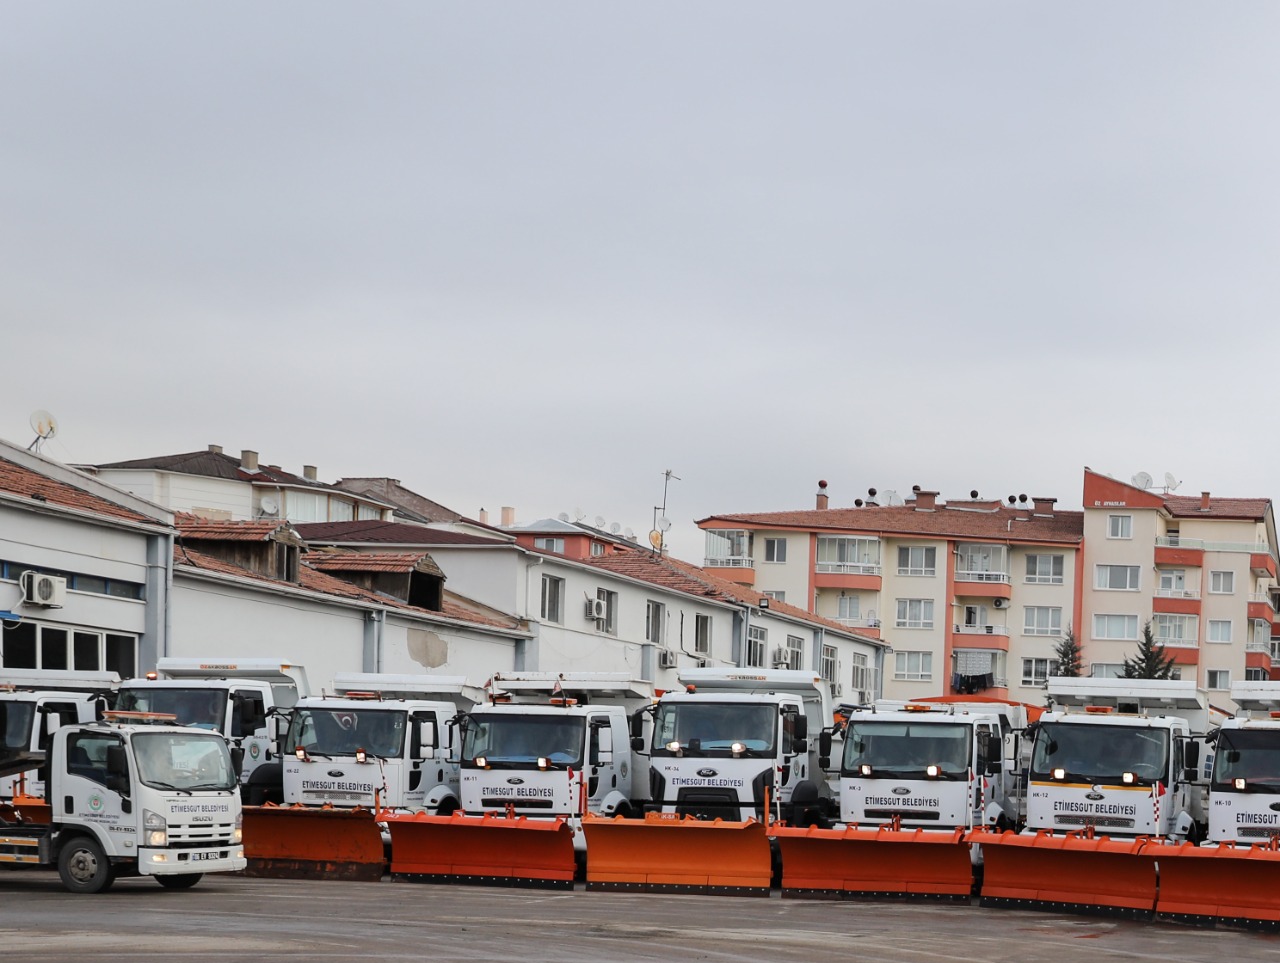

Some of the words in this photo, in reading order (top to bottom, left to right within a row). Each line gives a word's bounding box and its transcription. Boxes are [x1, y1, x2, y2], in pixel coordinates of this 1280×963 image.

[302, 780, 336, 789] ETİMESGUT
[337, 781, 373, 791] BELEDİYESİ
[672, 777, 706, 785] ETİMESGUT
[707, 778, 744, 787] BELEDİYESİ
[482, 787, 513, 796] ETİMESGUT
[516, 787, 554, 797] BELEDİYESİ
[865, 795, 900, 806] ETİMESGUT
[902, 797, 939, 807] BELEDİYESİ
[171, 804, 200, 812] ETİMESGUT
[202, 804, 229, 812] BELEDİYESİ
[1054, 800, 1093, 812] ETİMESGUT
[1095, 803, 1136, 815] BELEDİYESİ
[1236, 811, 1278, 824] ETİMESGUT
